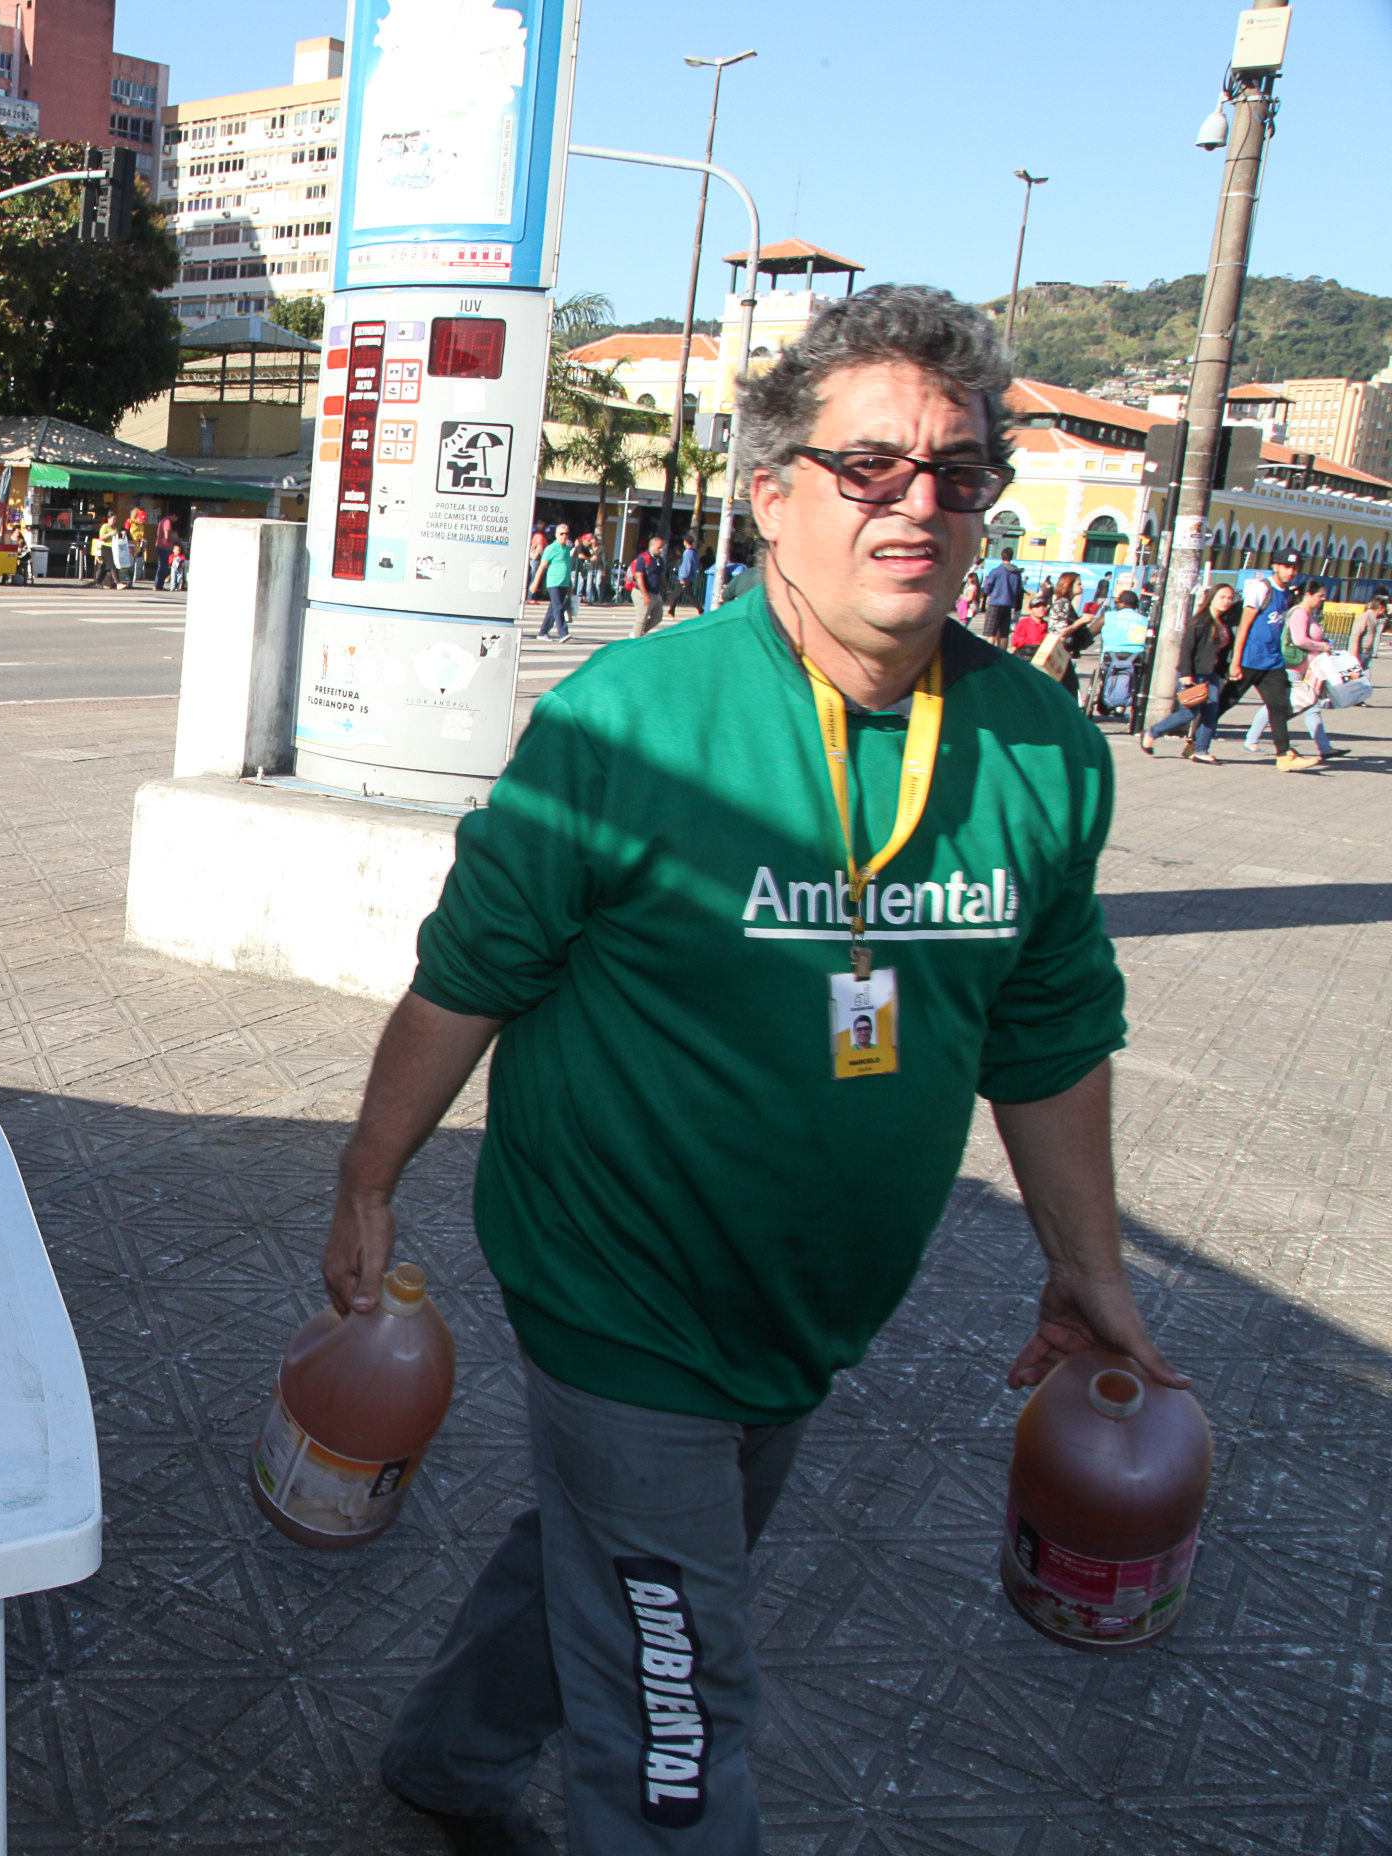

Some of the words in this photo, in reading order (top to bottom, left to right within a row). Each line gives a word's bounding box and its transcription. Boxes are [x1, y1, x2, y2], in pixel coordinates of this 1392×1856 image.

[498, 207, 504, 217] SE
[504, 119, 512, 138] BEBA
[459, 299, 483, 313] IUV
[354, 325, 385, 337] EXTREMO
[355, 380, 373, 391] ALTO
[352, 429, 369, 440] ALTO
[435, 502, 477, 512] PROTEJA-SE
[478, 505, 488, 513] DO
[428, 511, 442, 520] USE
[481, 514, 509, 524] ÓCULOS
[425, 521, 453, 530] CHAPÉU
[460, 523, 484, 532] FILTRO
[420, 530, 446, 540] MESMO
[446, 532, 458, 540] EM
[458, 533, 475, 542] DIAS
[476, 534, 510, 544] NUBLADO
[314, 684, 360, 700] PREFEITURA
[741, 866, 1006, 924] Ambiental
[624, 1577, 706, 1806] AMBIENTAL
